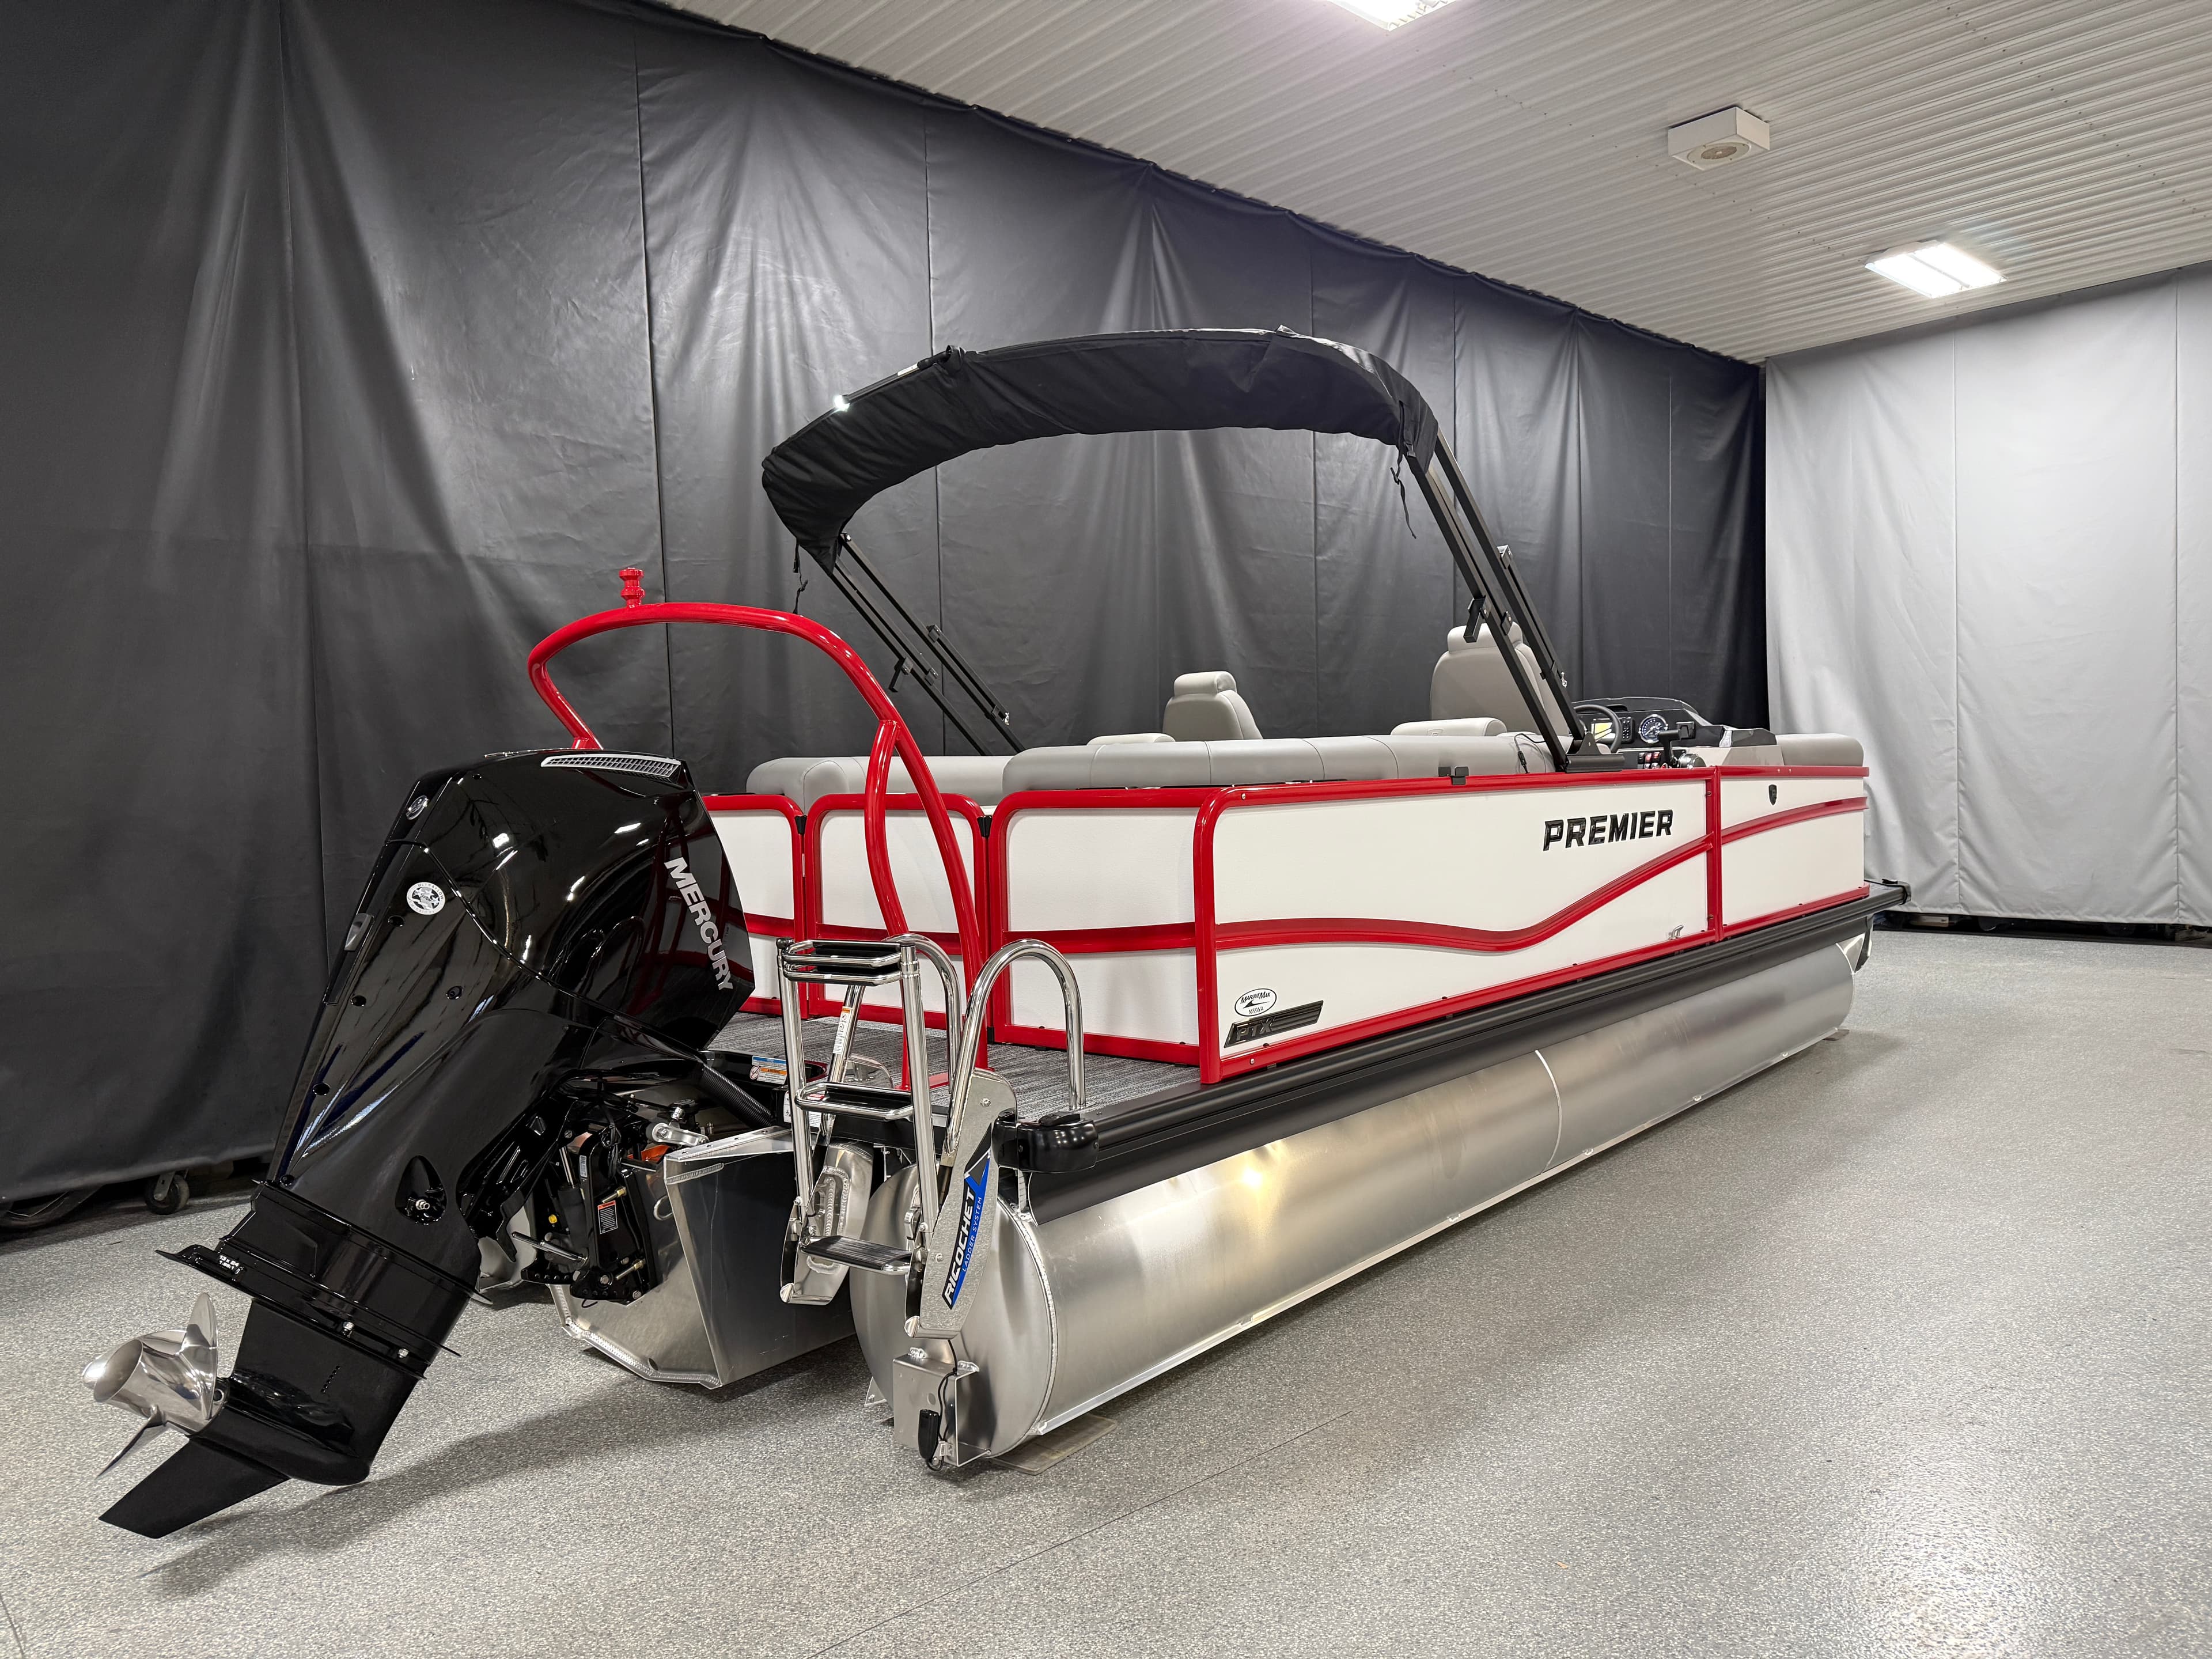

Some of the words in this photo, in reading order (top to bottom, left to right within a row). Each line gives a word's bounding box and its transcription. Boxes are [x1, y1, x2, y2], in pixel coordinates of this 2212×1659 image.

[1543, 809, 1673, 851] PREMIER
[664, 857, 733, 990] MERCURY
[1236, 1017, 1273, 1041] PTX
[944, 1187, 975, 1305] RICOCHET
[963, 1235, 975, 1272] LADDER
[972, 1197, 982, 1233] SYSTEM
